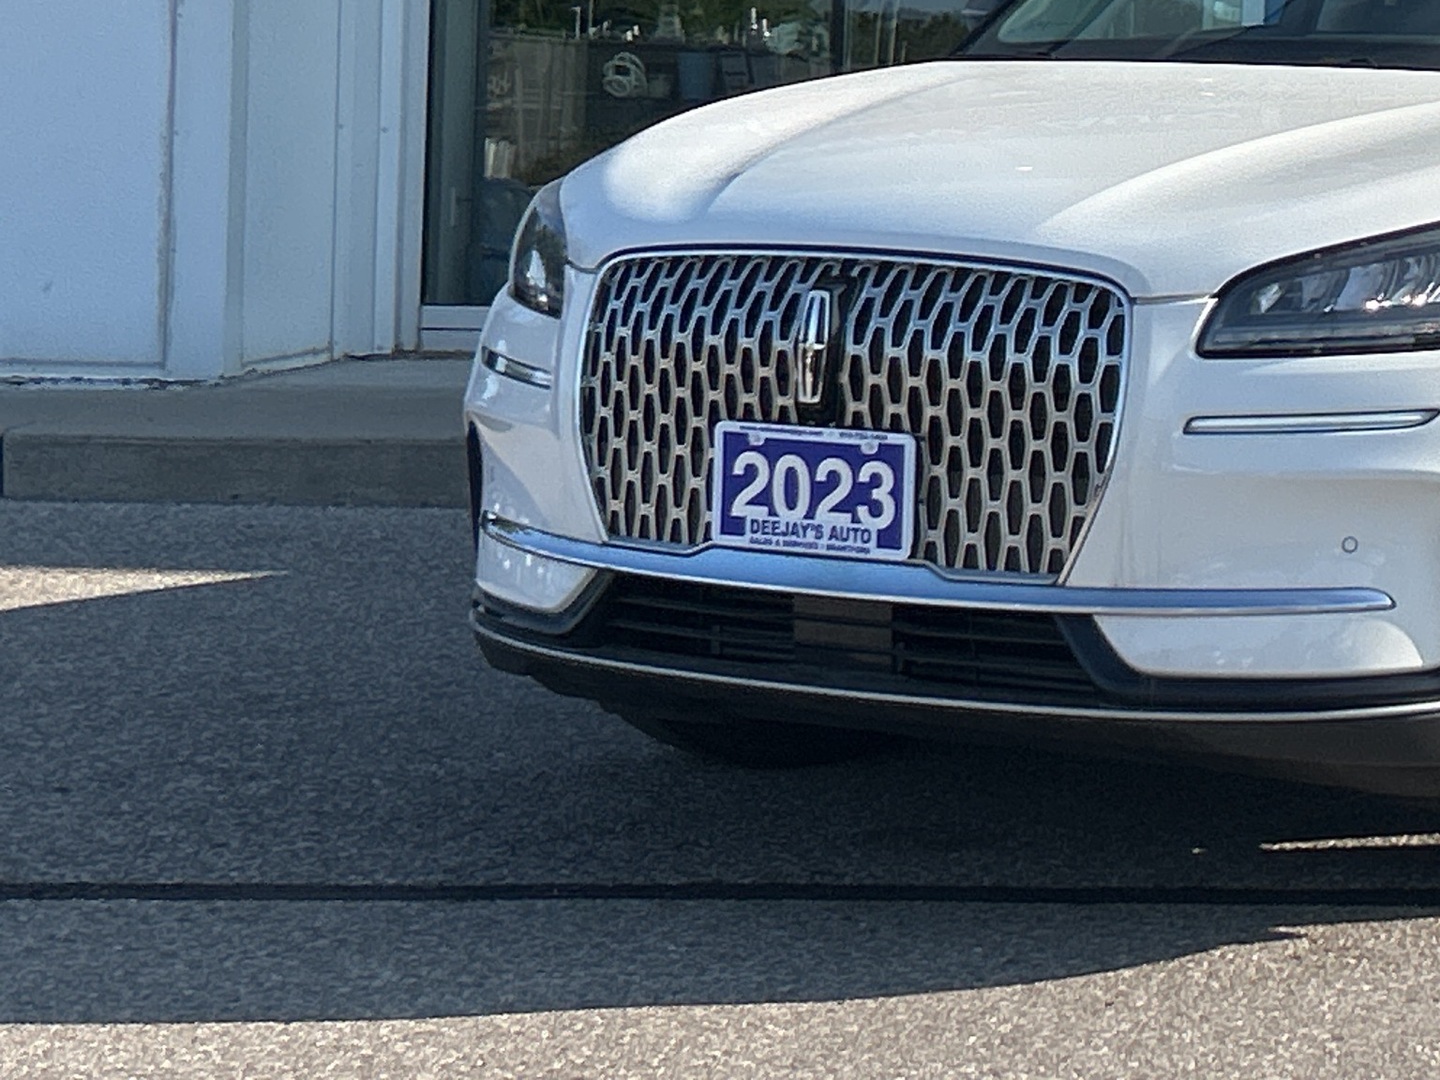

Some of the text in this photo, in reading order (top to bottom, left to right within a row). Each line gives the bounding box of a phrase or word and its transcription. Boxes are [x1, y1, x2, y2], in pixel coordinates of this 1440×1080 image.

[730, 451, 896, 530] 2023
[749, 519, 873, 544] DEEJAY'S AUTO
